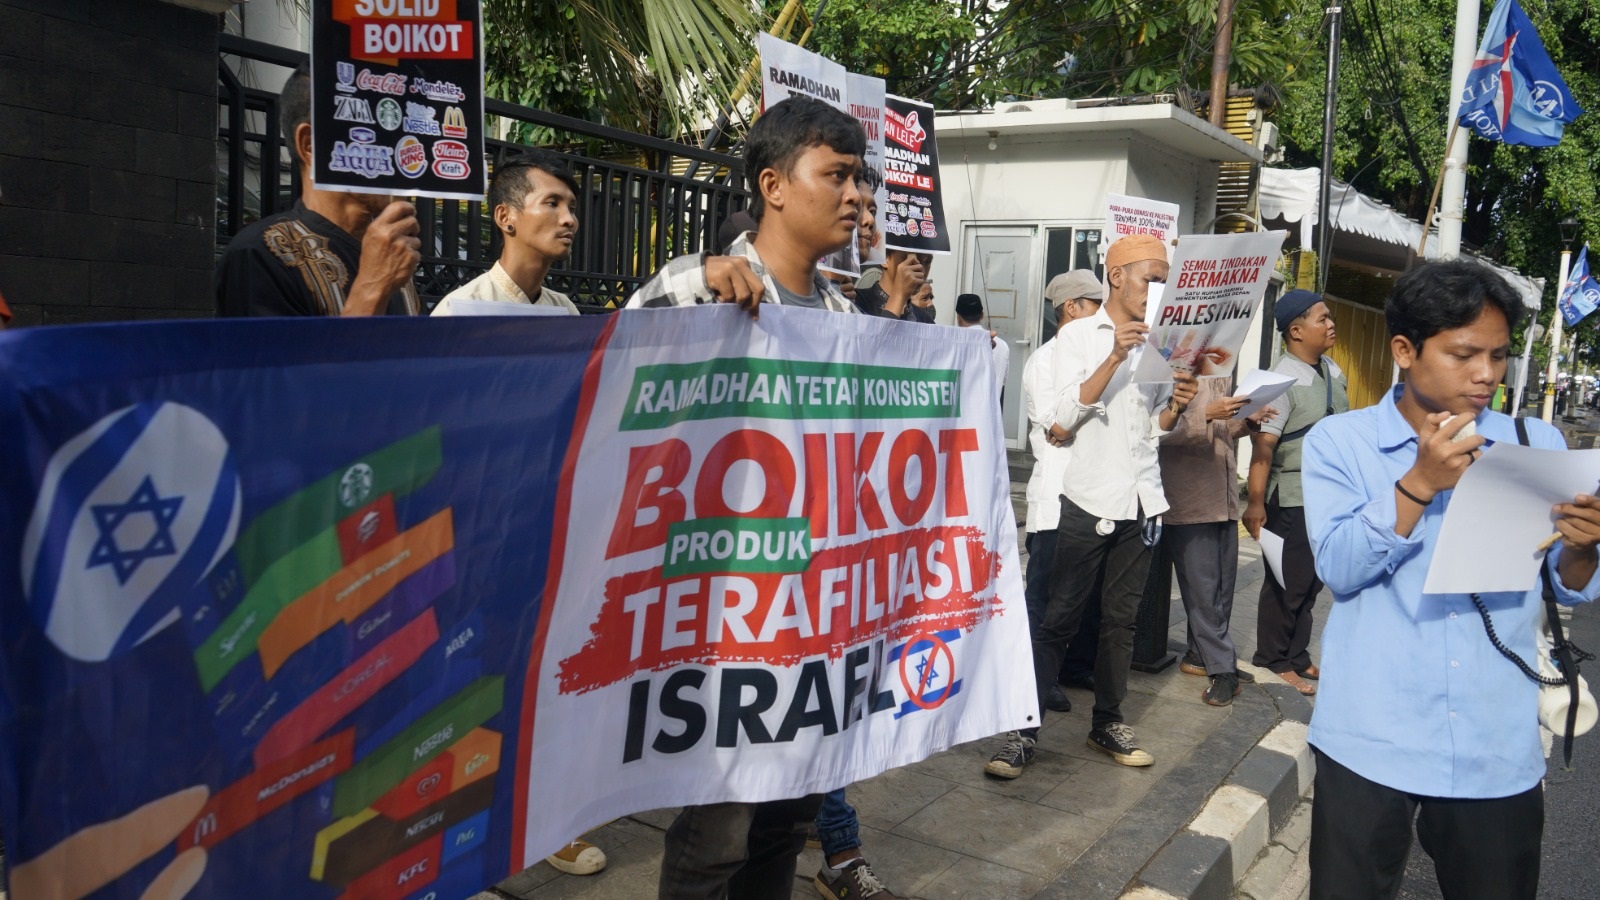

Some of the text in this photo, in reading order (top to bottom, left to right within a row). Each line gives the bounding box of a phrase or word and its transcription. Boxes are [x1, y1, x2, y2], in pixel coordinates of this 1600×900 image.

[355, 0, 440, 17] SOLID
[364, 24, 463, 54] BOIKOT
[769, 66, 841, 103] RAMADHAN
[850, 104, 880, 121] TINDAKAN
[1533, 85, 1559, 118] 14
[896, 126, 914, 148] LELE
[401, 151, 424, 166] KING
[441, 163, 461, 174] Kraft
[916, 175, 931, 188] LE
[1139, 218, 1154, 228] 100%
[1181, 256, 1268, 272] SEMUA TINDAKAN
[1176, 267, 1260, 289] BERMAKNA
[1159, 299, 1254, 327] PALESTINA
[633, 372, 958, 415] RAMADHAN TETAP KONSISTEN
[605, 428, 980, 561] BOIKOT
[669, 529, 809, 566] PRODUK
[622, 535, 974, 661] TERAFILIASI
[622, 639, 896, 764] ISRAEL
[257, 752, 337, 801] McDonald's
[397, 858, 429, 885] KFC
